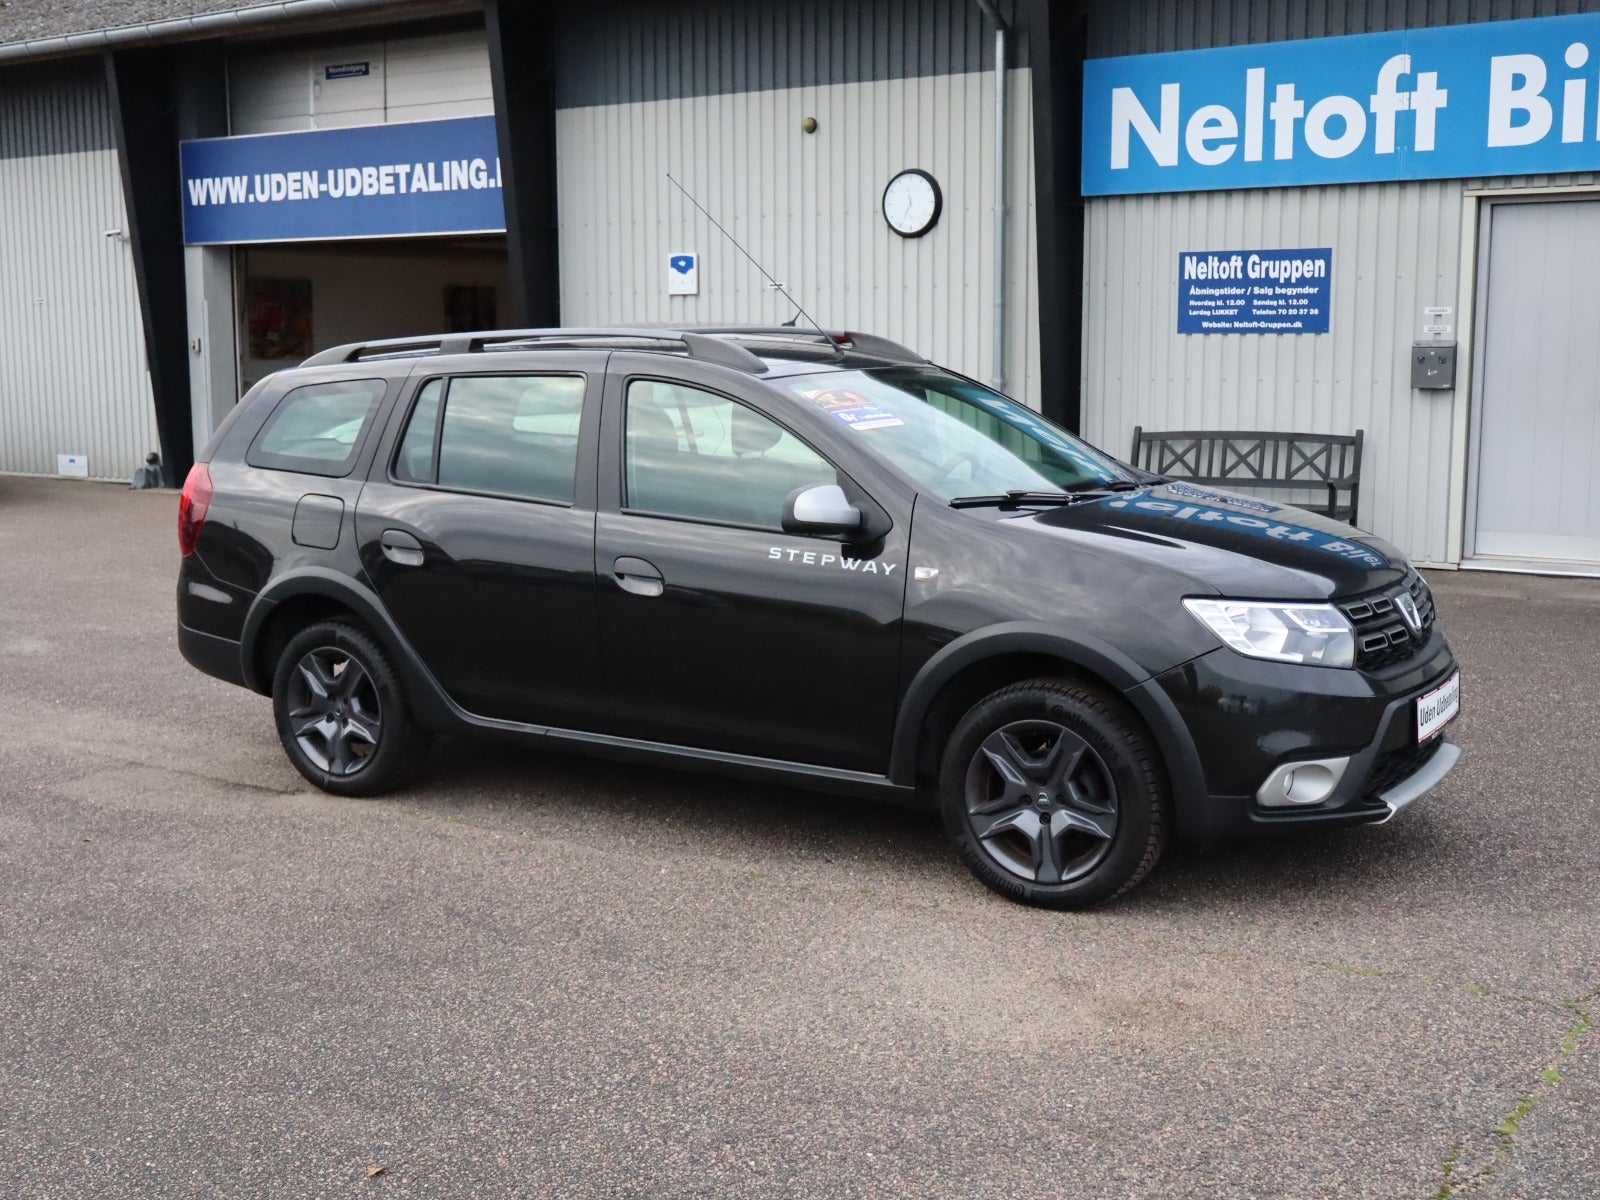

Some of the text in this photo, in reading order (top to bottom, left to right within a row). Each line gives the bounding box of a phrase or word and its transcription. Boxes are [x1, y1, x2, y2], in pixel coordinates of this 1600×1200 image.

[1110, 41, 1600, 170] Neltoft Bi
[188, 157, 502, 206] WWW.UDEN-UDBETALING.
[1184, 254, 1326, 284] Neltoft Gruppen
[1189, 285, 1246, 296] Åbningstider
[1253, 286, 1273, 296] Salg
[1275, 286, 1319, 296] begynder
[768, 547, 897, 576] STEPWAY
[1420, 705, 1436, 727] Uden
